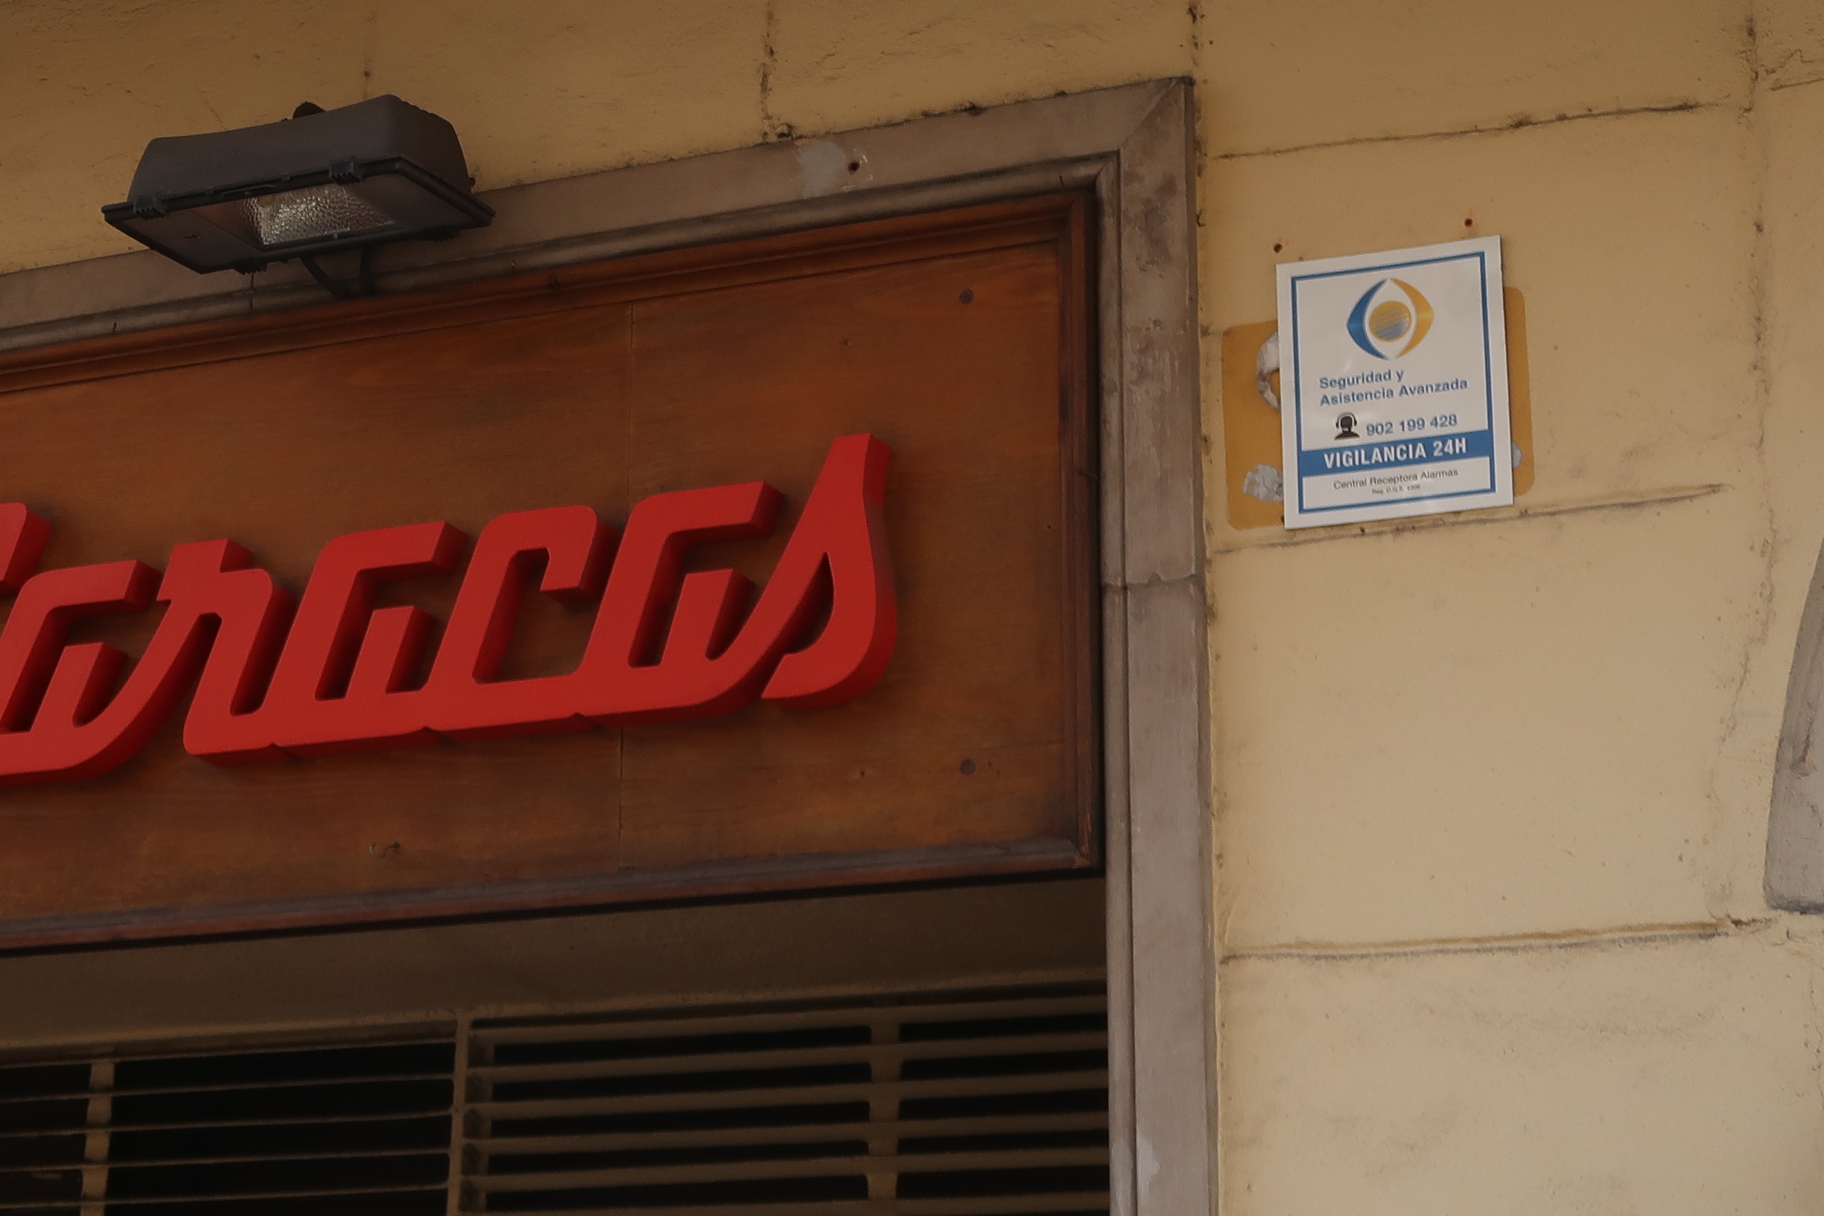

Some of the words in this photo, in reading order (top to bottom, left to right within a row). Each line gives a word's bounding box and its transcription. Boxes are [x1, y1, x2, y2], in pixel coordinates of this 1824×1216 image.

[1319, 369, 1392, 389] Seguridad
[1395, 369, 1405, 383] y
[1319, 387, 1394, 406] Asistencia
[1398, 377, 1468, 397] Avanzada
[1366, 421, 1394, 436] 902
[1399, 417, 1426, 432] 199
[1429, 413, 1458, 427] 428
[1323, 442, 1427, 469] VIGILANCIA
[1432, 436, 1467, 457] 24H
[1333, 477, 1367, 490] Central
[1370, 472, 1418, 486] Receptora
[1420, 467, 1459, 480] Alarmas
